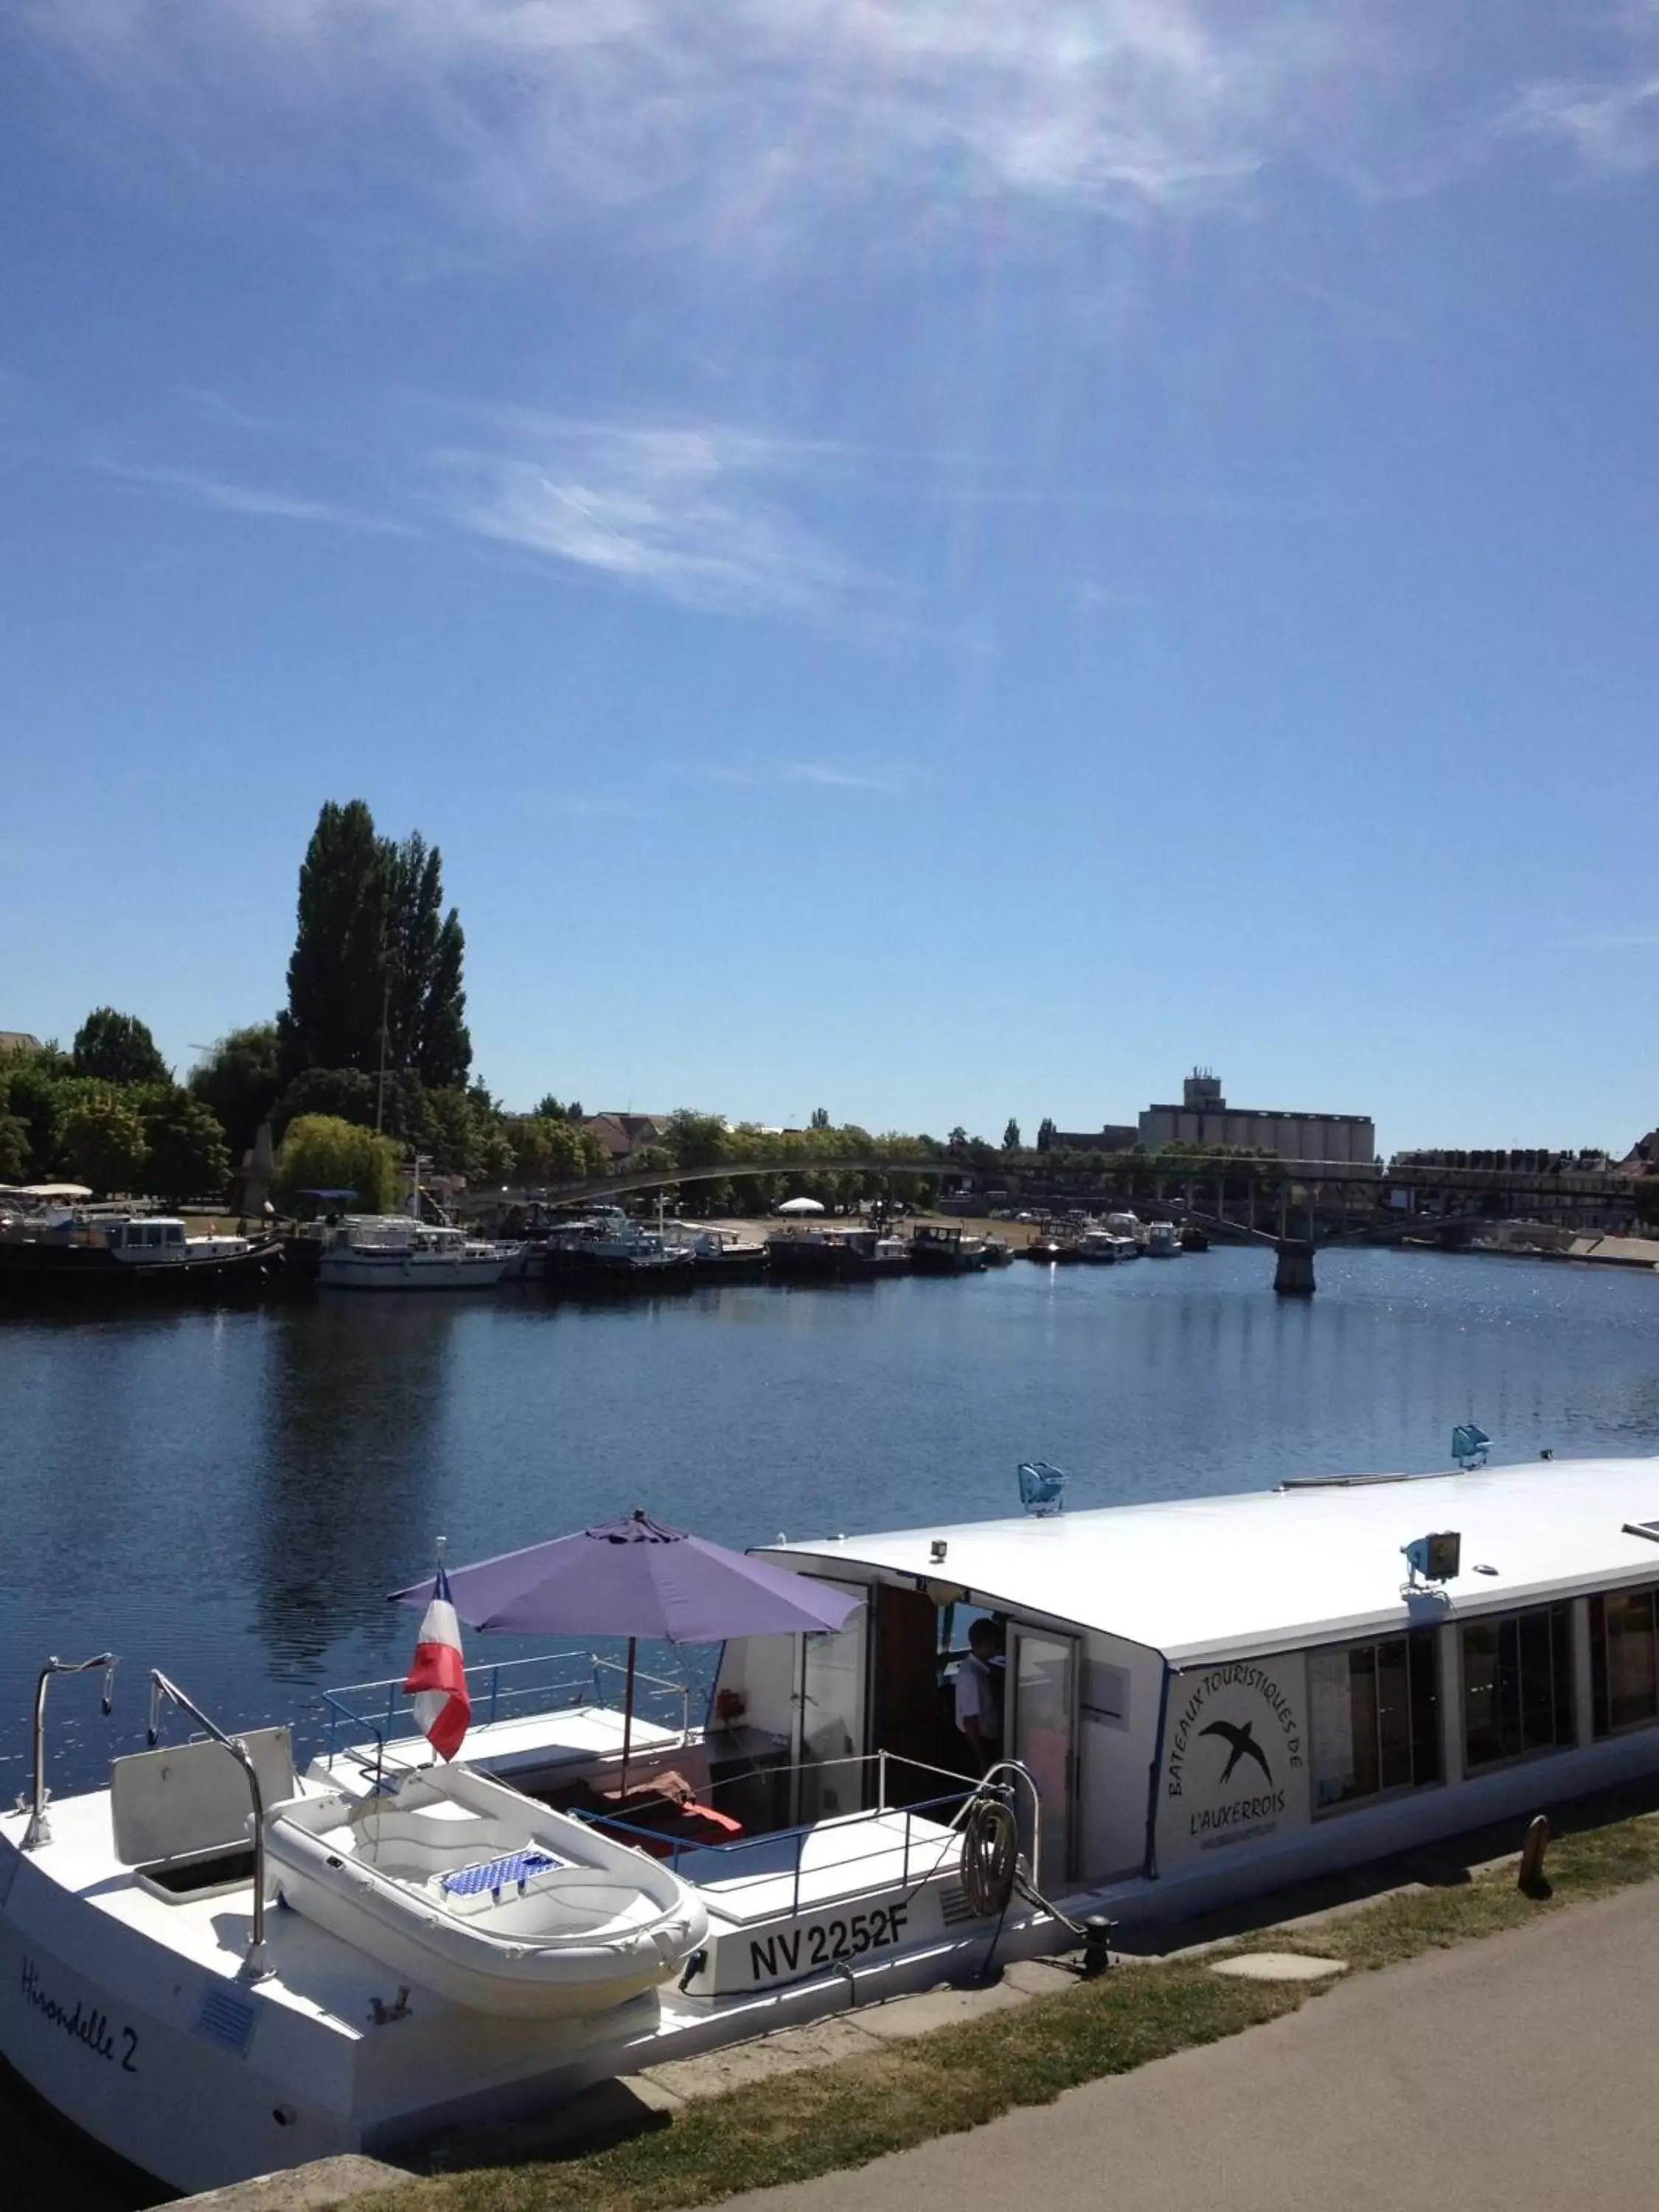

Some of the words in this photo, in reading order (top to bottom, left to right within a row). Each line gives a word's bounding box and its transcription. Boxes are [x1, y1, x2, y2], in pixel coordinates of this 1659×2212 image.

[1169, 1686, 1205, 1797] BATEAUX
[1203, 1664, 1296, 1733] TOURISTIQUES
[1287, 1736, 1303, 1770] DE
[1190, 1789, 1286, 1836] L'AUXERROIS
[21, 1955, 114, 2060] Hirondelle
[122, 2026, 138, 2072] 2
